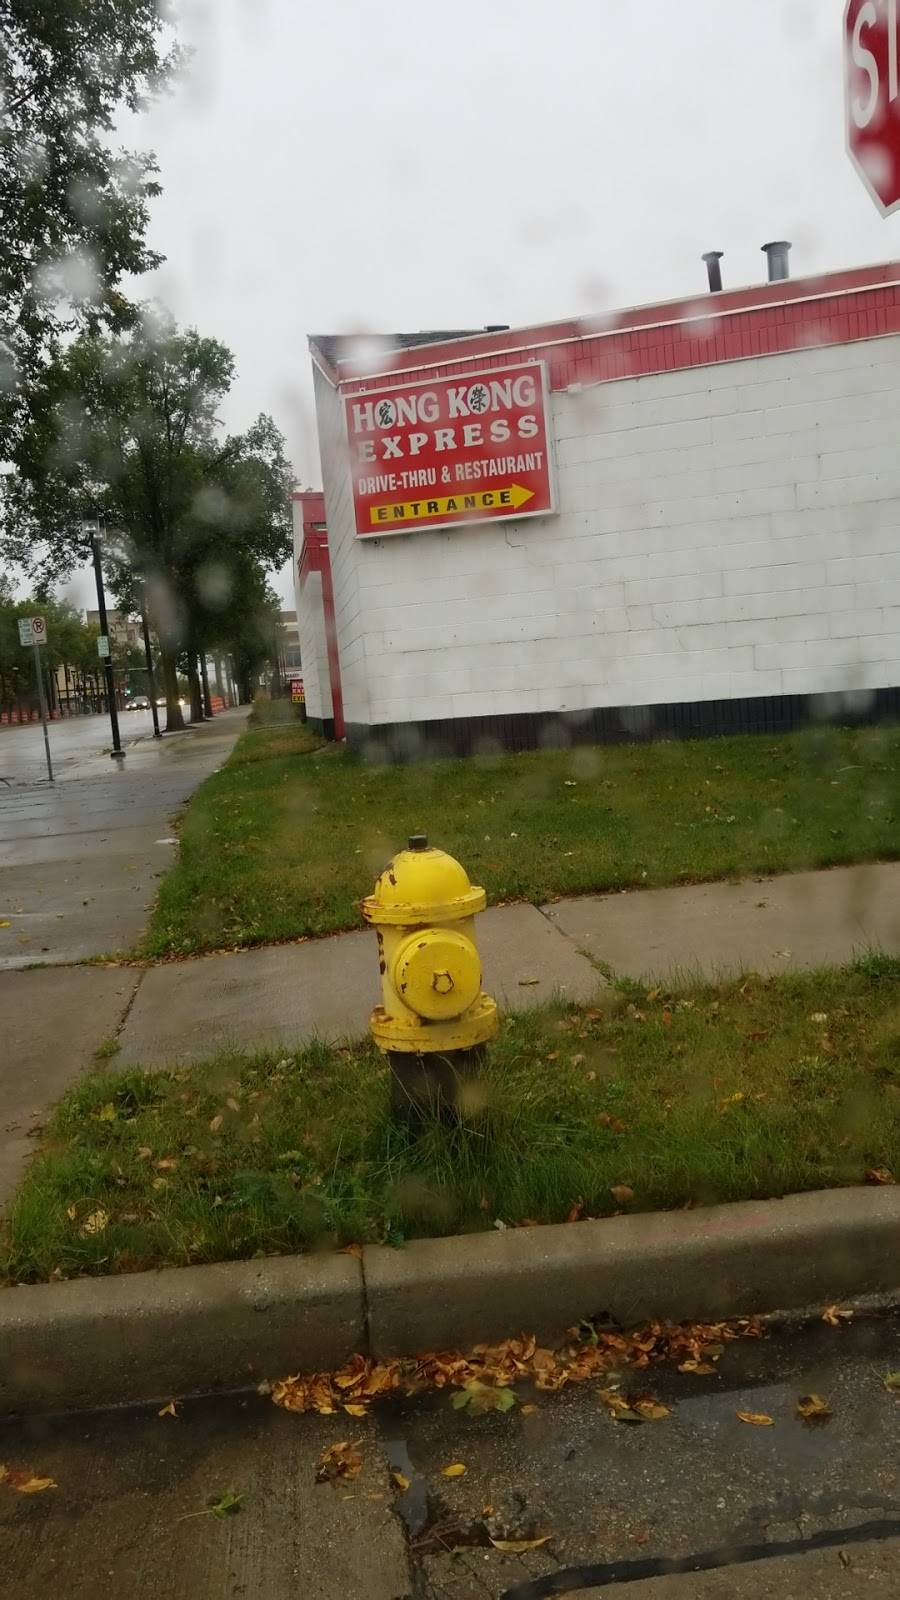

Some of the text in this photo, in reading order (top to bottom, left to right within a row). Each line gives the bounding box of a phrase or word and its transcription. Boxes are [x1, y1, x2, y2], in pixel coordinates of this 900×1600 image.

[352, 375, 536, 433] HONG KONG
[358, 414, 539, 464] EXPRESS
[358, 452, 543, 496] DRIVE-THRU & RESTAURANT
[377, 490, 511, 521] ENTRANCE
